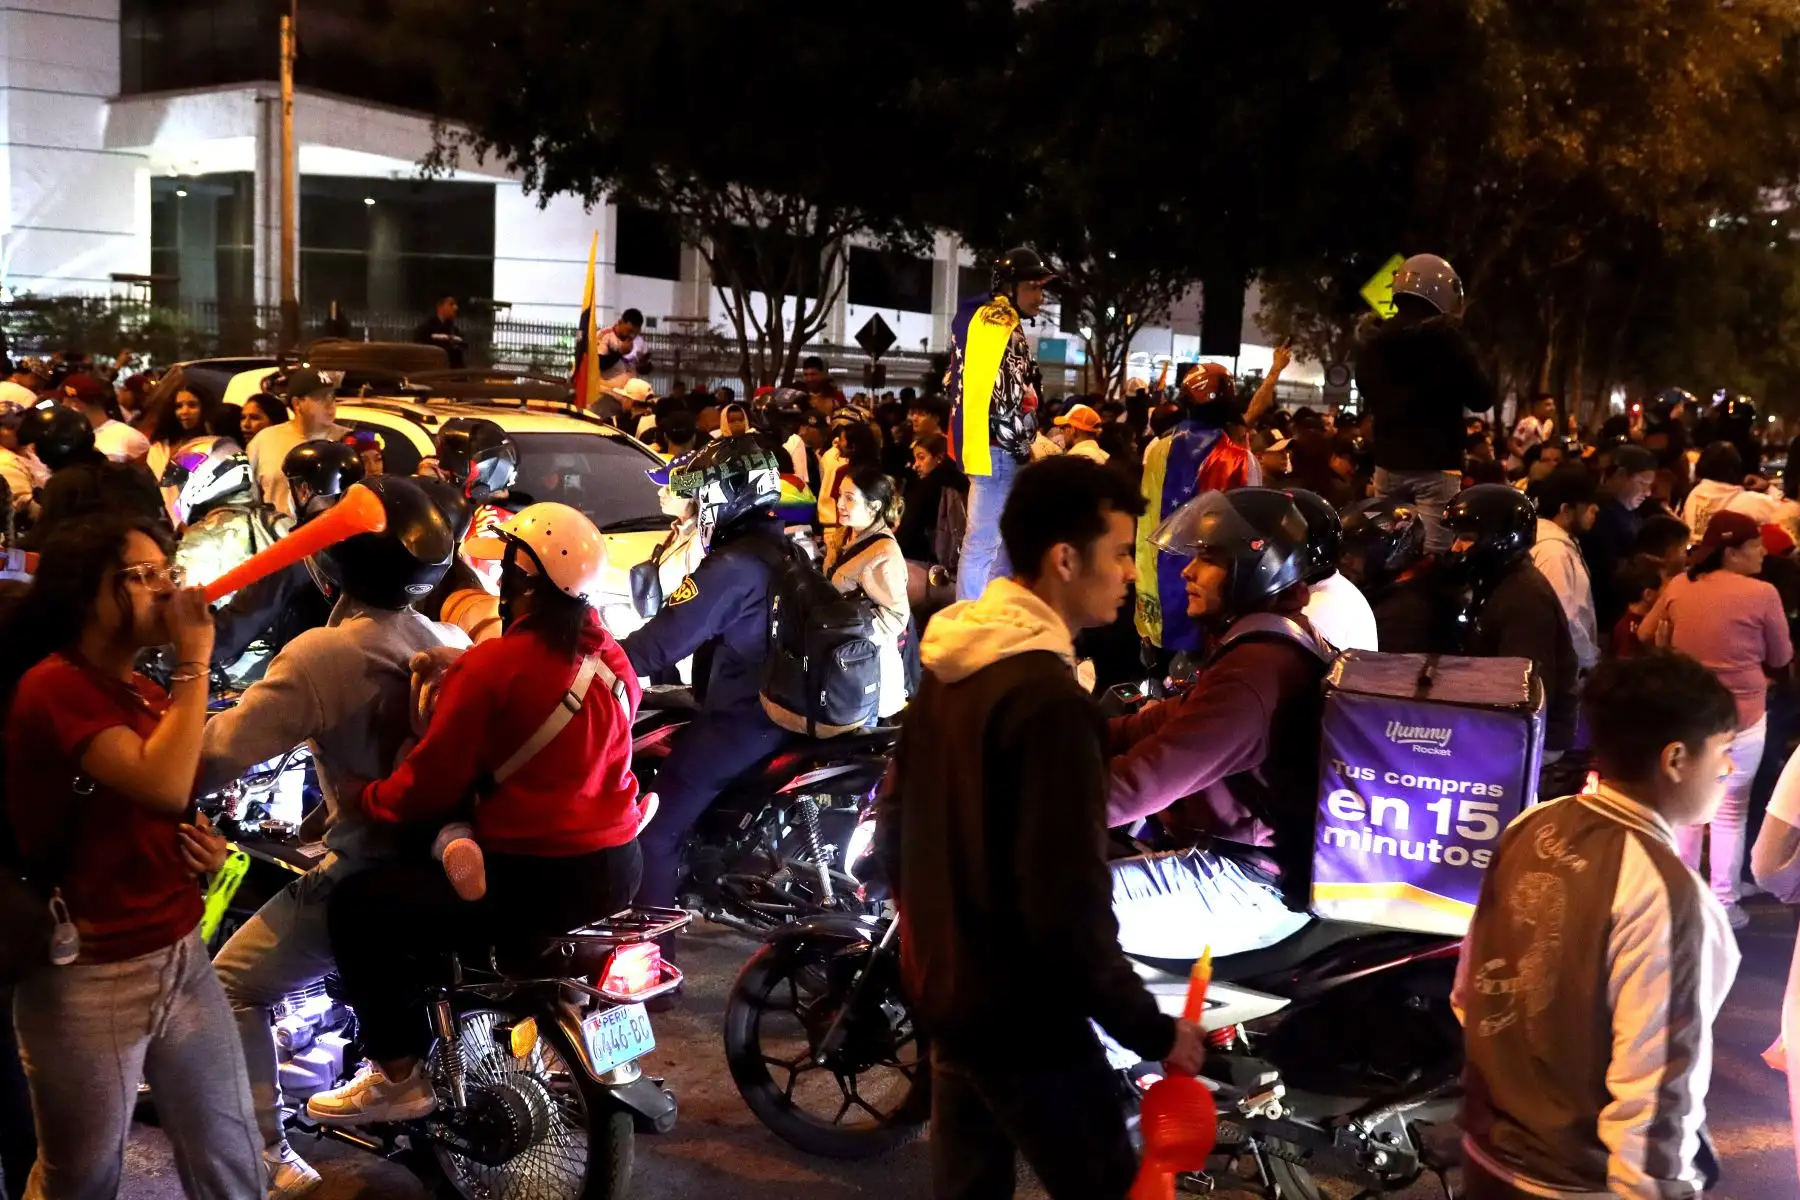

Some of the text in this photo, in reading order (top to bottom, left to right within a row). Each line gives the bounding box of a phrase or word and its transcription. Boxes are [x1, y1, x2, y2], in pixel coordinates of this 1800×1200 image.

[1385, 721, 1452, 747] Yummy
[1412, 744, 1452, 757] Rocket
[1332, 759, 1504, 798] Tus compras
[1327, 788, 1500, 841] en 15
[1323, 825, 1494, 869] minutos
[603, 1009, 627, 1027] PERU
